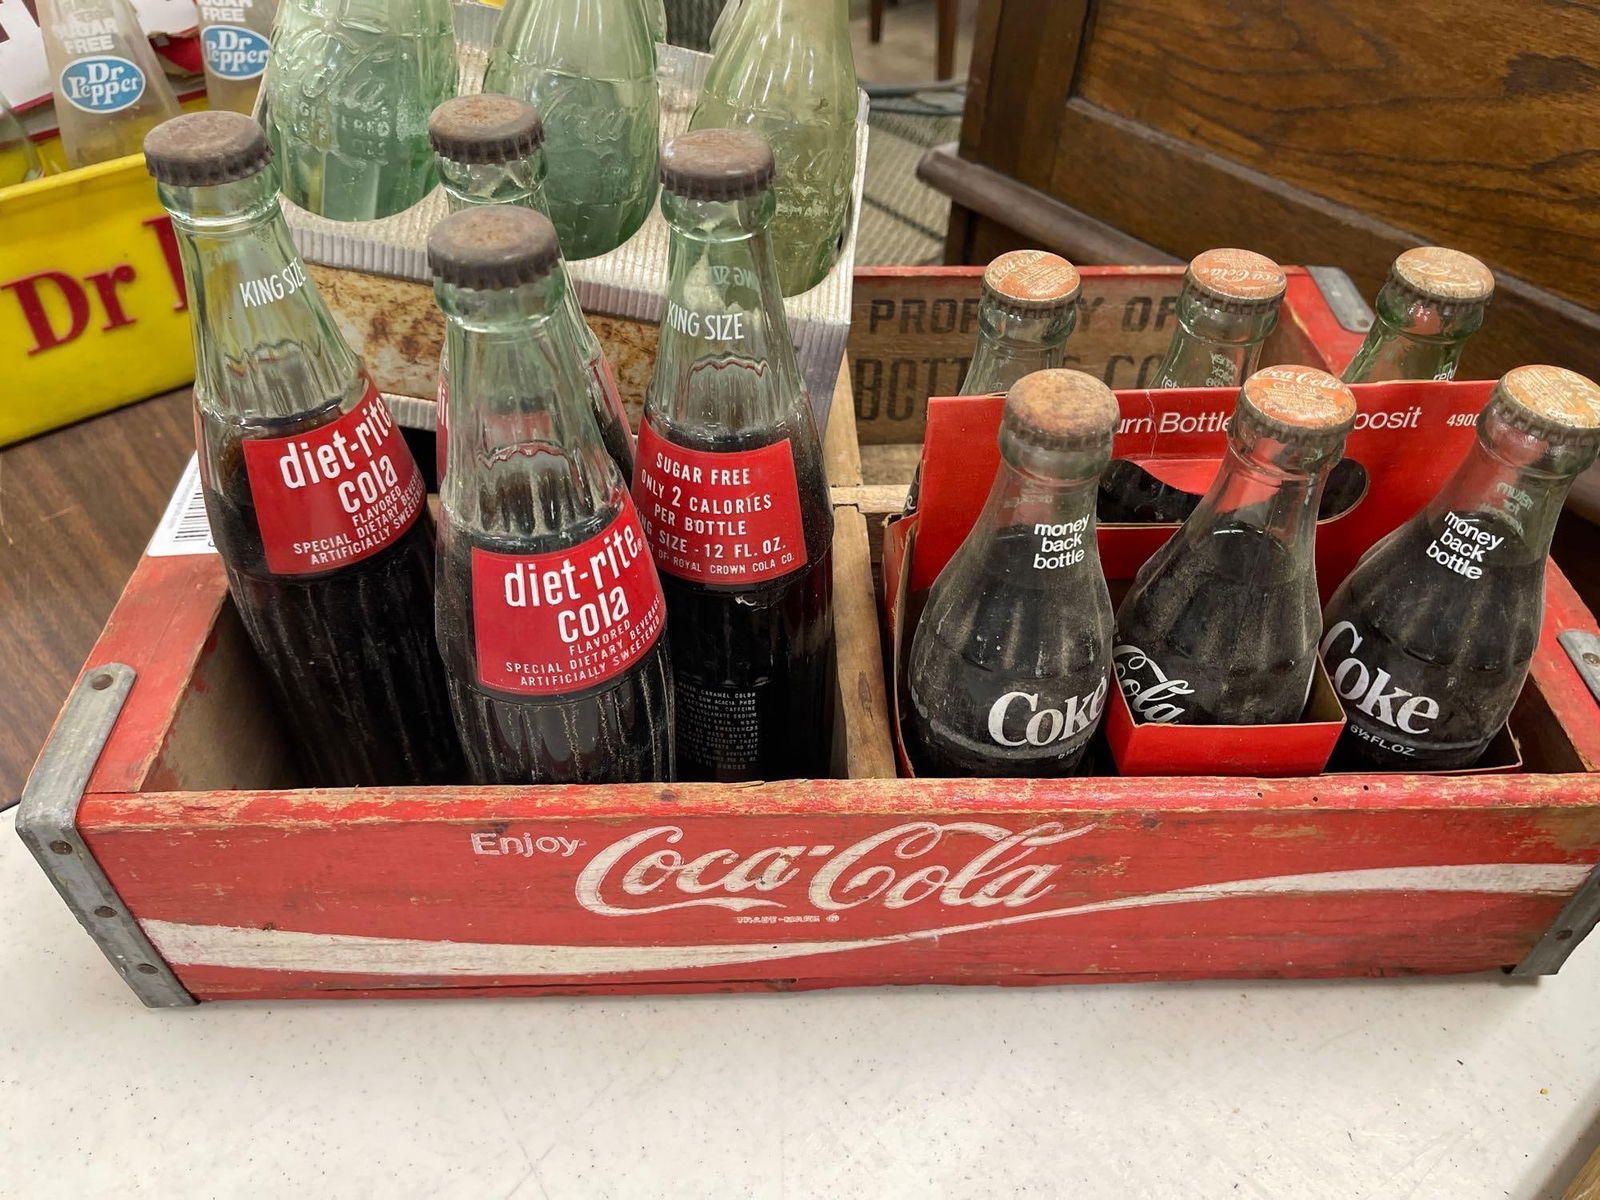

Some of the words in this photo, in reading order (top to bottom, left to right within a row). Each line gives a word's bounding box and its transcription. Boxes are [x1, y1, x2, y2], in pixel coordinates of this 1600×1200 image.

[202, 7, 246, 22] FREE
[63, 34, 115, 55] FREE
[205, 40, 270, 72] Pepper
[218, 30, 252, 50] Dr
[67, 76, 139, 106] Pepper
[86, 62, 125, 84] Dr
[239, 274, 285, 308] KING
[282, 257, 306, 294] SIZE
[0, 262, 137, 357] Dr
[667, 300, 700, 337] KING
[704, 312, 745, 340] SIZE
[279, 397, 393, 489] diet-rite
[337, 455, 399, 514] cola
[656, 452, 702, 484] SUGAR
[711, 468, 751, 486] FREE
[352, 485, 402, 527] FLAVORED
[641, 468, 665, 499] ONLY
[672, 486, 681, 507] 2
[689, 494, 772, 515] CALORIES
[293, 533, 352, 554] SPECIAL
[356, 503, 399, 538] DIETARY
[654, 503, 676, 526] PER
[684, 517, 747, 536] BOTTLE
[1034, 514, 1090, 538] money
[1444, 511, 1505, 551] money
[311, 525, 391, 565] ARTIFICIALLY
[658, 530, 688, 553] SIZE
[704, 543, 724, 559] 12
[735, 544, 758, 558] FL.
[763, 536, 786, 555] OZ.
[1033, 548, 1085, 569] bottle
[1041, 533, 1083, 552] back
[1426, 540, 1483, 580] bottle
[1440, 528, 1487, 562] back
[673, 556, 702, 572] ROYAL
[710, 564, 746, 575] CROWN
[752, 559, 776, 573] COLA
[506, 662, 563, 674] SPECIAL
[569, 639, 623, 670] DIETARY
[629, 593, 661, 640] BEVERAGE
[557, 586, 630, 643] cola
[520, 663, 607, 686] ARTIFICIALLY
[612, 614, 662, 667] SWEETENED
[569, 619, 631, 657] FLAVORED
[1320, 620, 1440, 735] Coke
[987, 675, 1108, 747] Coke
[470, 832, 581, 857] Enjoy
[575, 822, 1099, 917] Coca-Cola
